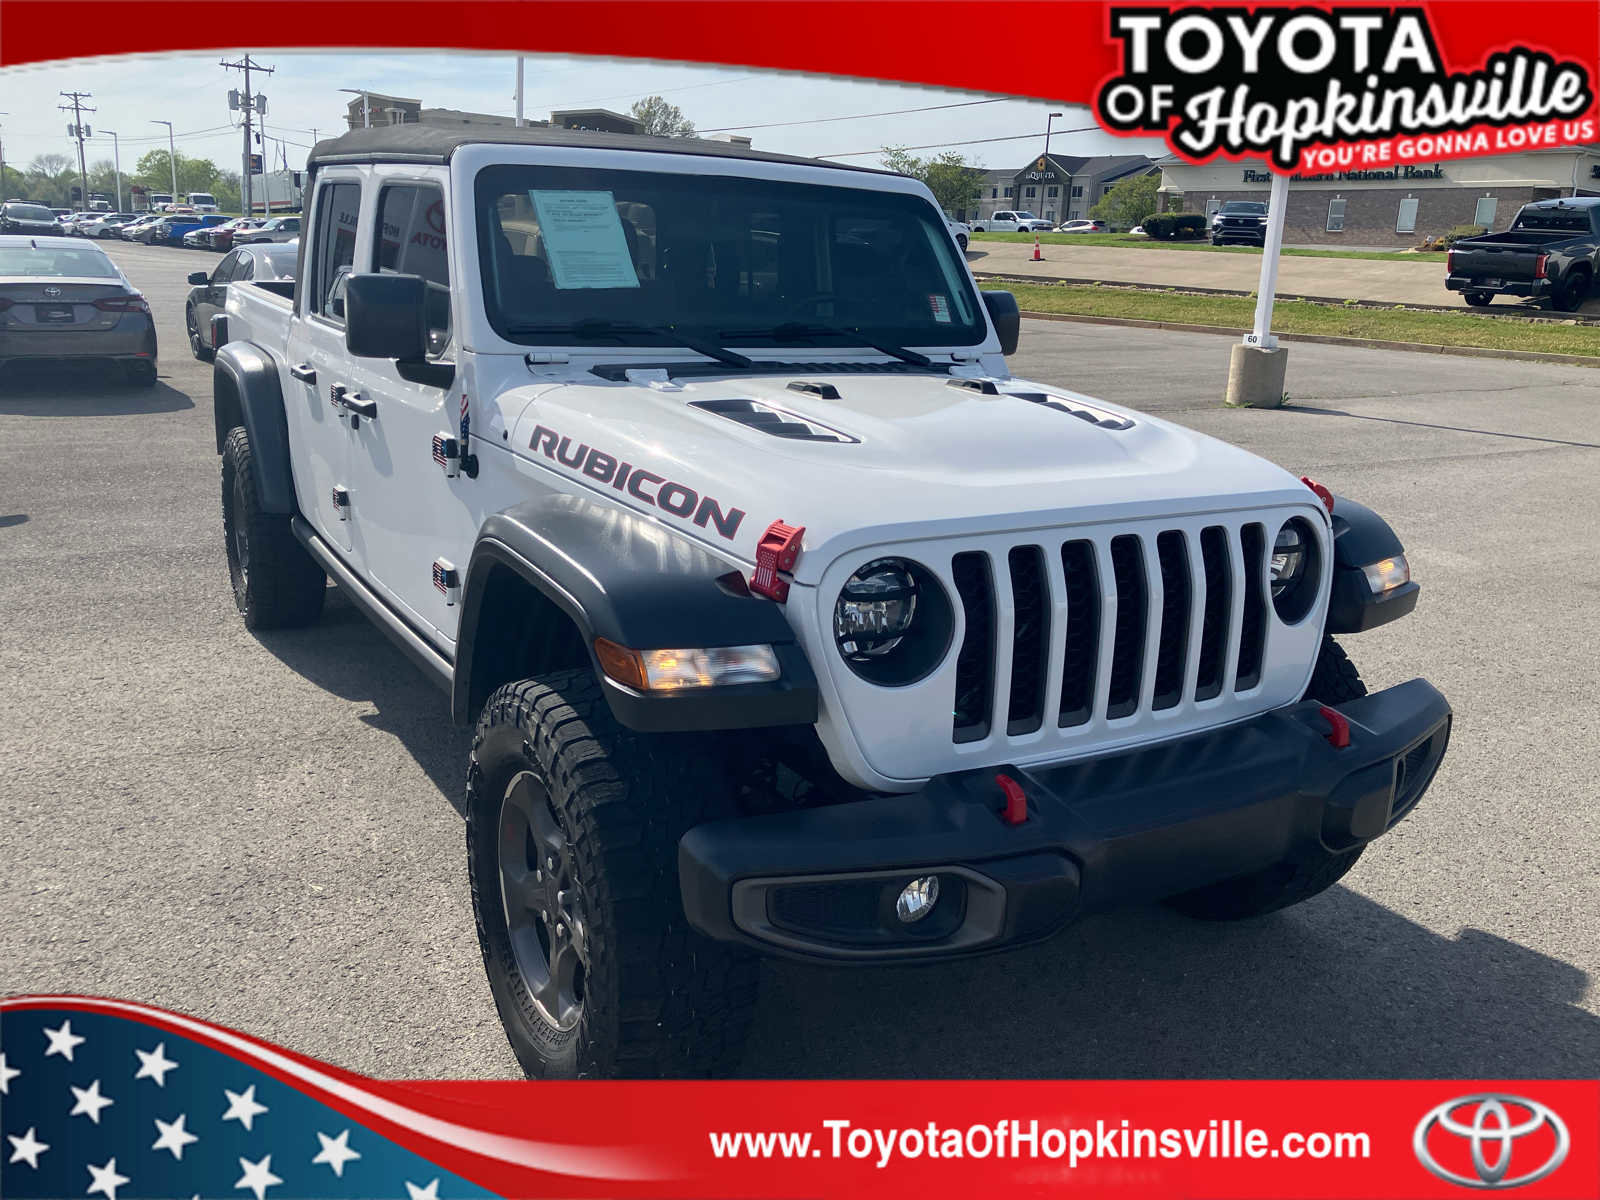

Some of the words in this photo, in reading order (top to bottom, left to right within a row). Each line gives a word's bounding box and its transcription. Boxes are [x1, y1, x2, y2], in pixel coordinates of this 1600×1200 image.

[1402, 163, 1444, 180] Bank
[1247, 335, 1258, 343] 60
[528, 424, 746, 541] RUBICON
